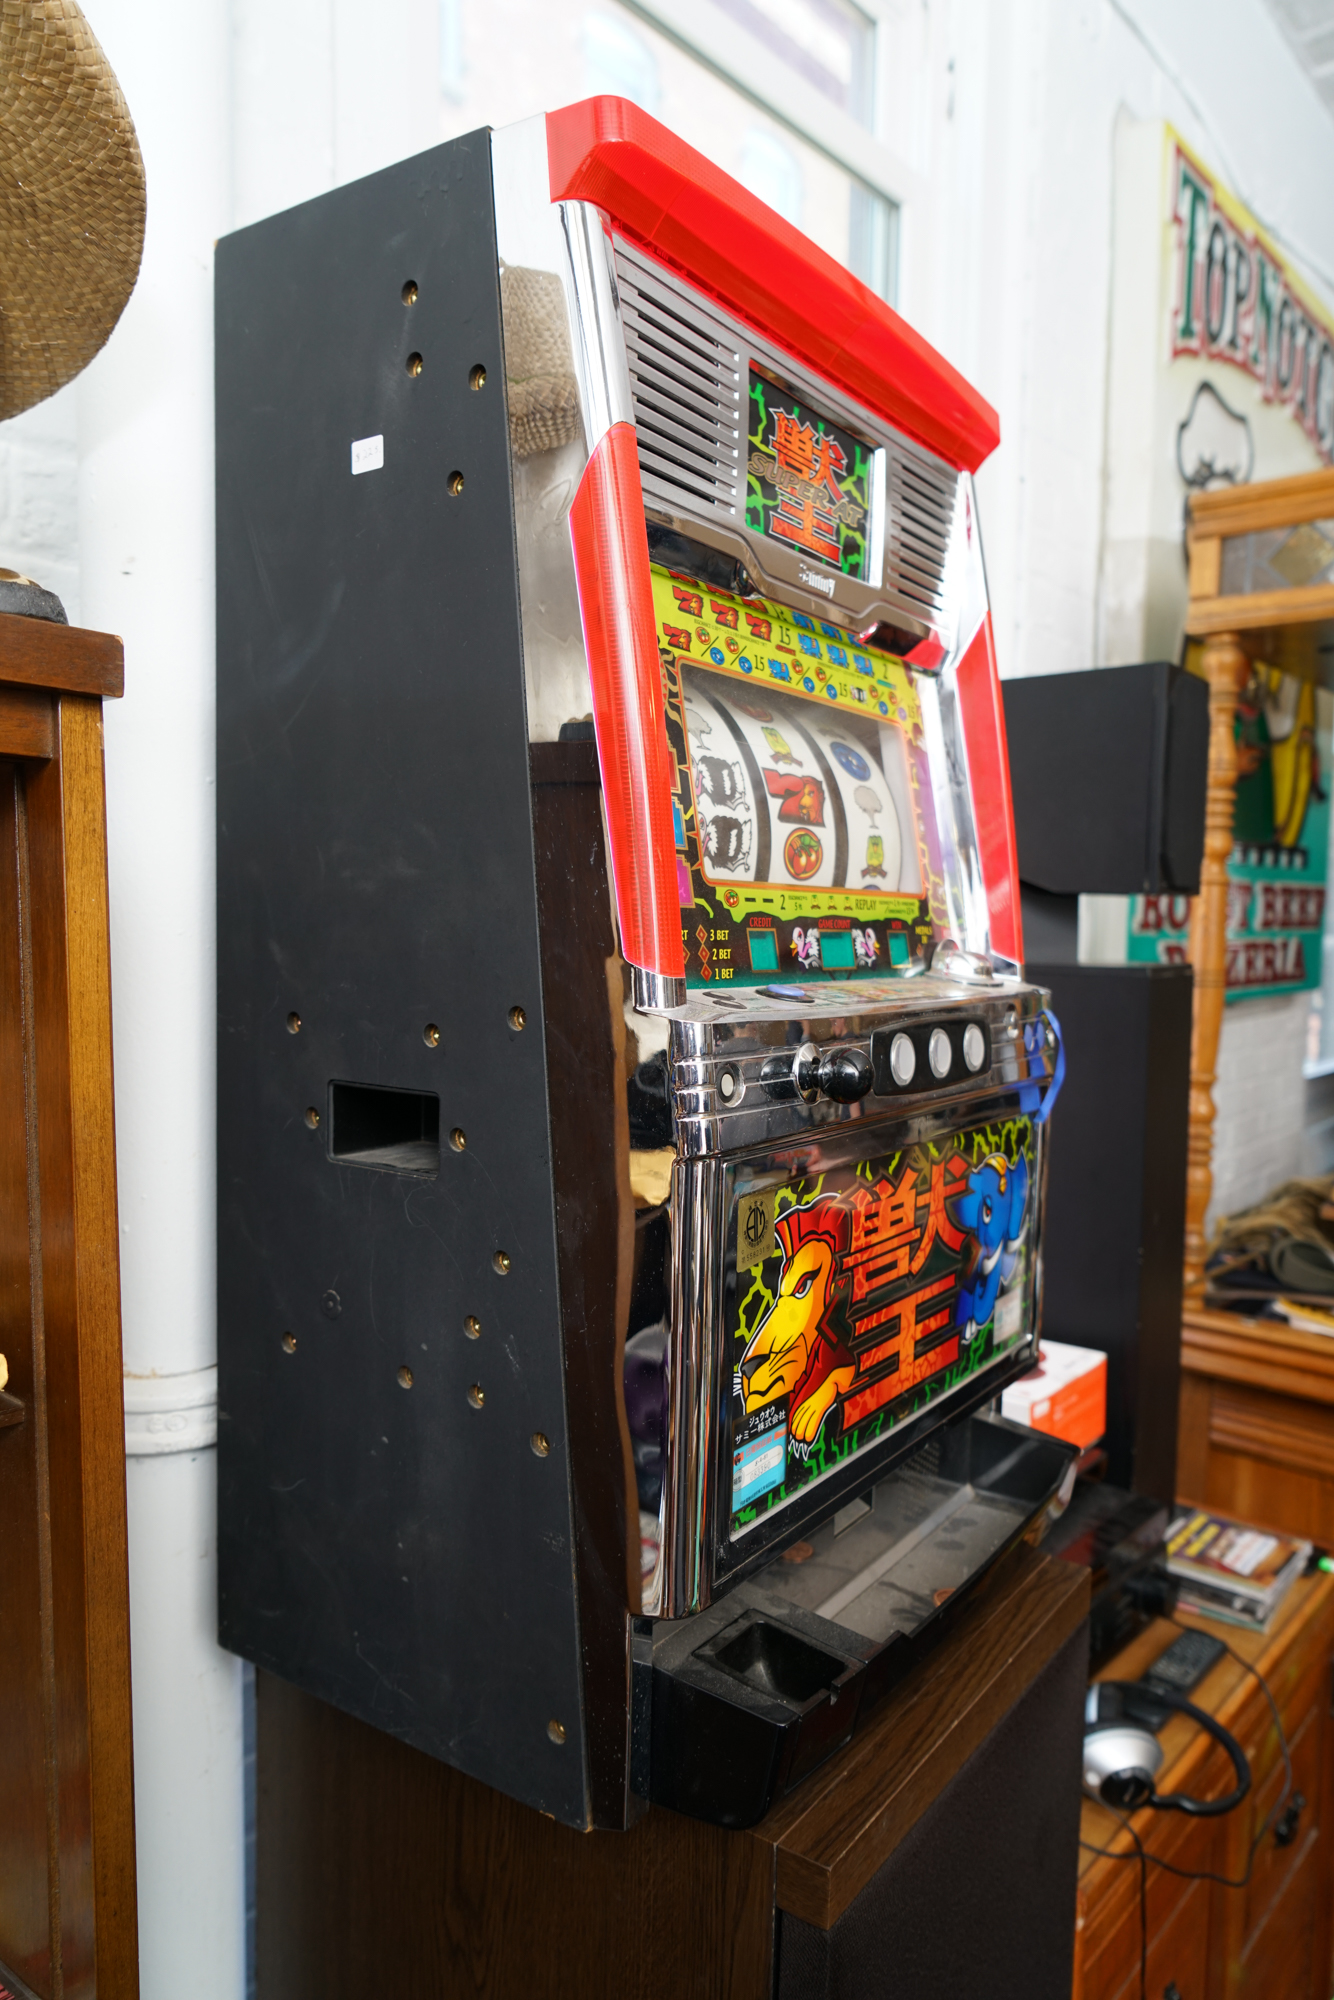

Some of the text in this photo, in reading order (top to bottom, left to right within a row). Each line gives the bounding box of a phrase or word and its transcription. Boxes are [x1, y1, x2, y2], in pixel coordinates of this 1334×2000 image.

[748, 451, 863, 527] SUPER AT
[779, 625, 791, 645] 15
[754, 654, 765, 671] 15
[780, 894, 786, 911] 2
[855, 899, 877, 911] REPLAY
[1140, 884, 1252, 931] ROT
[749, 917, 772, 928] CREDIT
[818, 919, 851, 929] GAME COUNT
[891, 921, 902, 929] WIN
[710, 929, 729, 941] 3 BET
[712, 949, 731, 960] 2 BET
[715, 968, 734, 980] 1 BET
[749, 1405, 776, 1427] ジュウオウ
[735, 1410, 786, 1445] サミー株式会社
